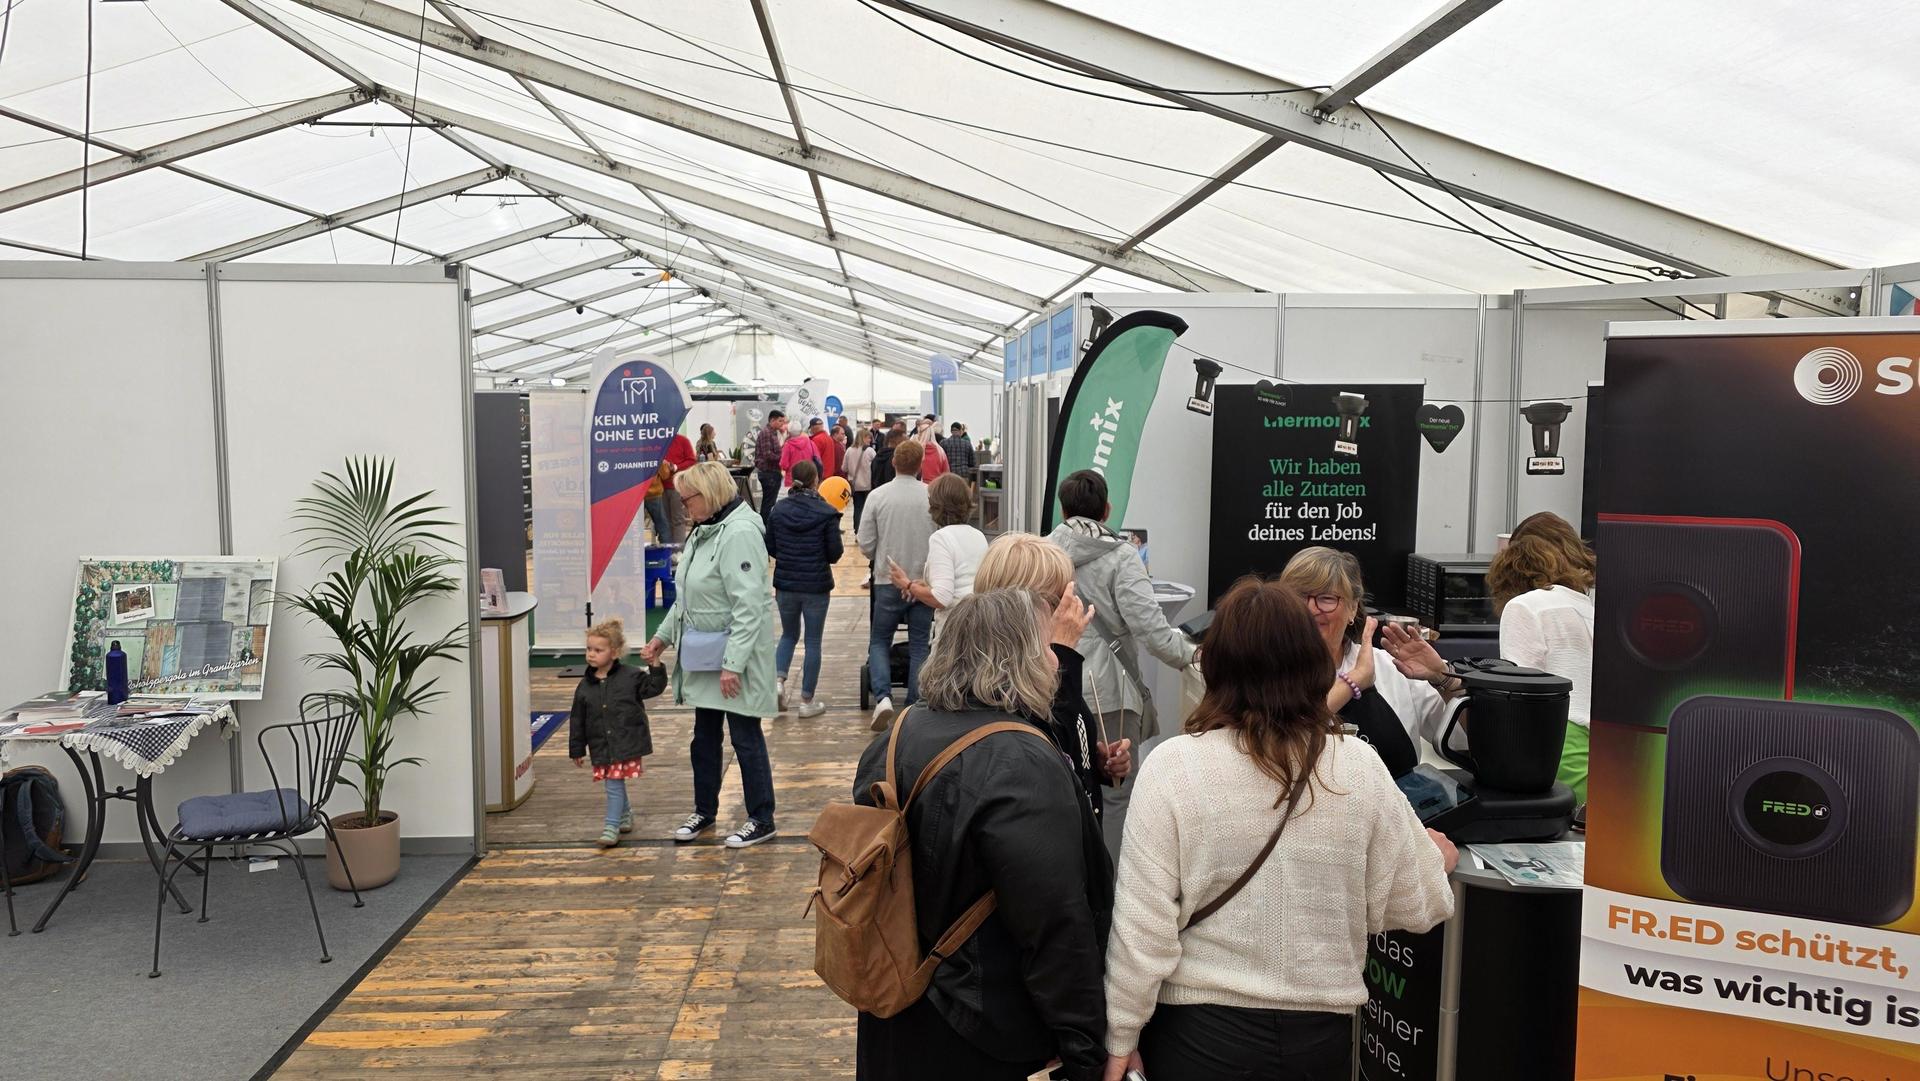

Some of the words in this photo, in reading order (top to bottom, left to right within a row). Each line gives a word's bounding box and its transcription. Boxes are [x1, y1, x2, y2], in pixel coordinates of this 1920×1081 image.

[1874, 356, 1920, 395] S
[594, 415, 627, 427] KEIN
[630, 412, 659, 425] WIR
[594, 430, 634, 442] OHNE
[638, 427, 675, 440] EUCH
[614, 460, 659, 470] JOHANNITER
[1269, 459, 1302, 475] Wir
[1308, 458, 1362, 475] haben
[1262, 480, 1294, 497] alle
[1300, 481, 1367, 497] Zutaten
[1265, 502, 1292, 519] für
[1297, 502, 1330, 519] den
[1335, 502, 1363, 522] Job
[1248, 524, 1305, 541] deines
[1310, 522, 1377, 541] Lebens!
[188, 668, 201, 679] im
[202, 656, 261, 676] Granitgarten
[1762, 800, 1811, 816] FRED
[1375, 930, 1414, 968] das
[1608, 904, 1725, 945] FR.ED
[1735, 929, 1909, 979] schützt,
[1624, 964, 1704, 995] was
[1713, 975, 1872, 1027] wichtig
[1365, 998, 1424, 1046] einer
